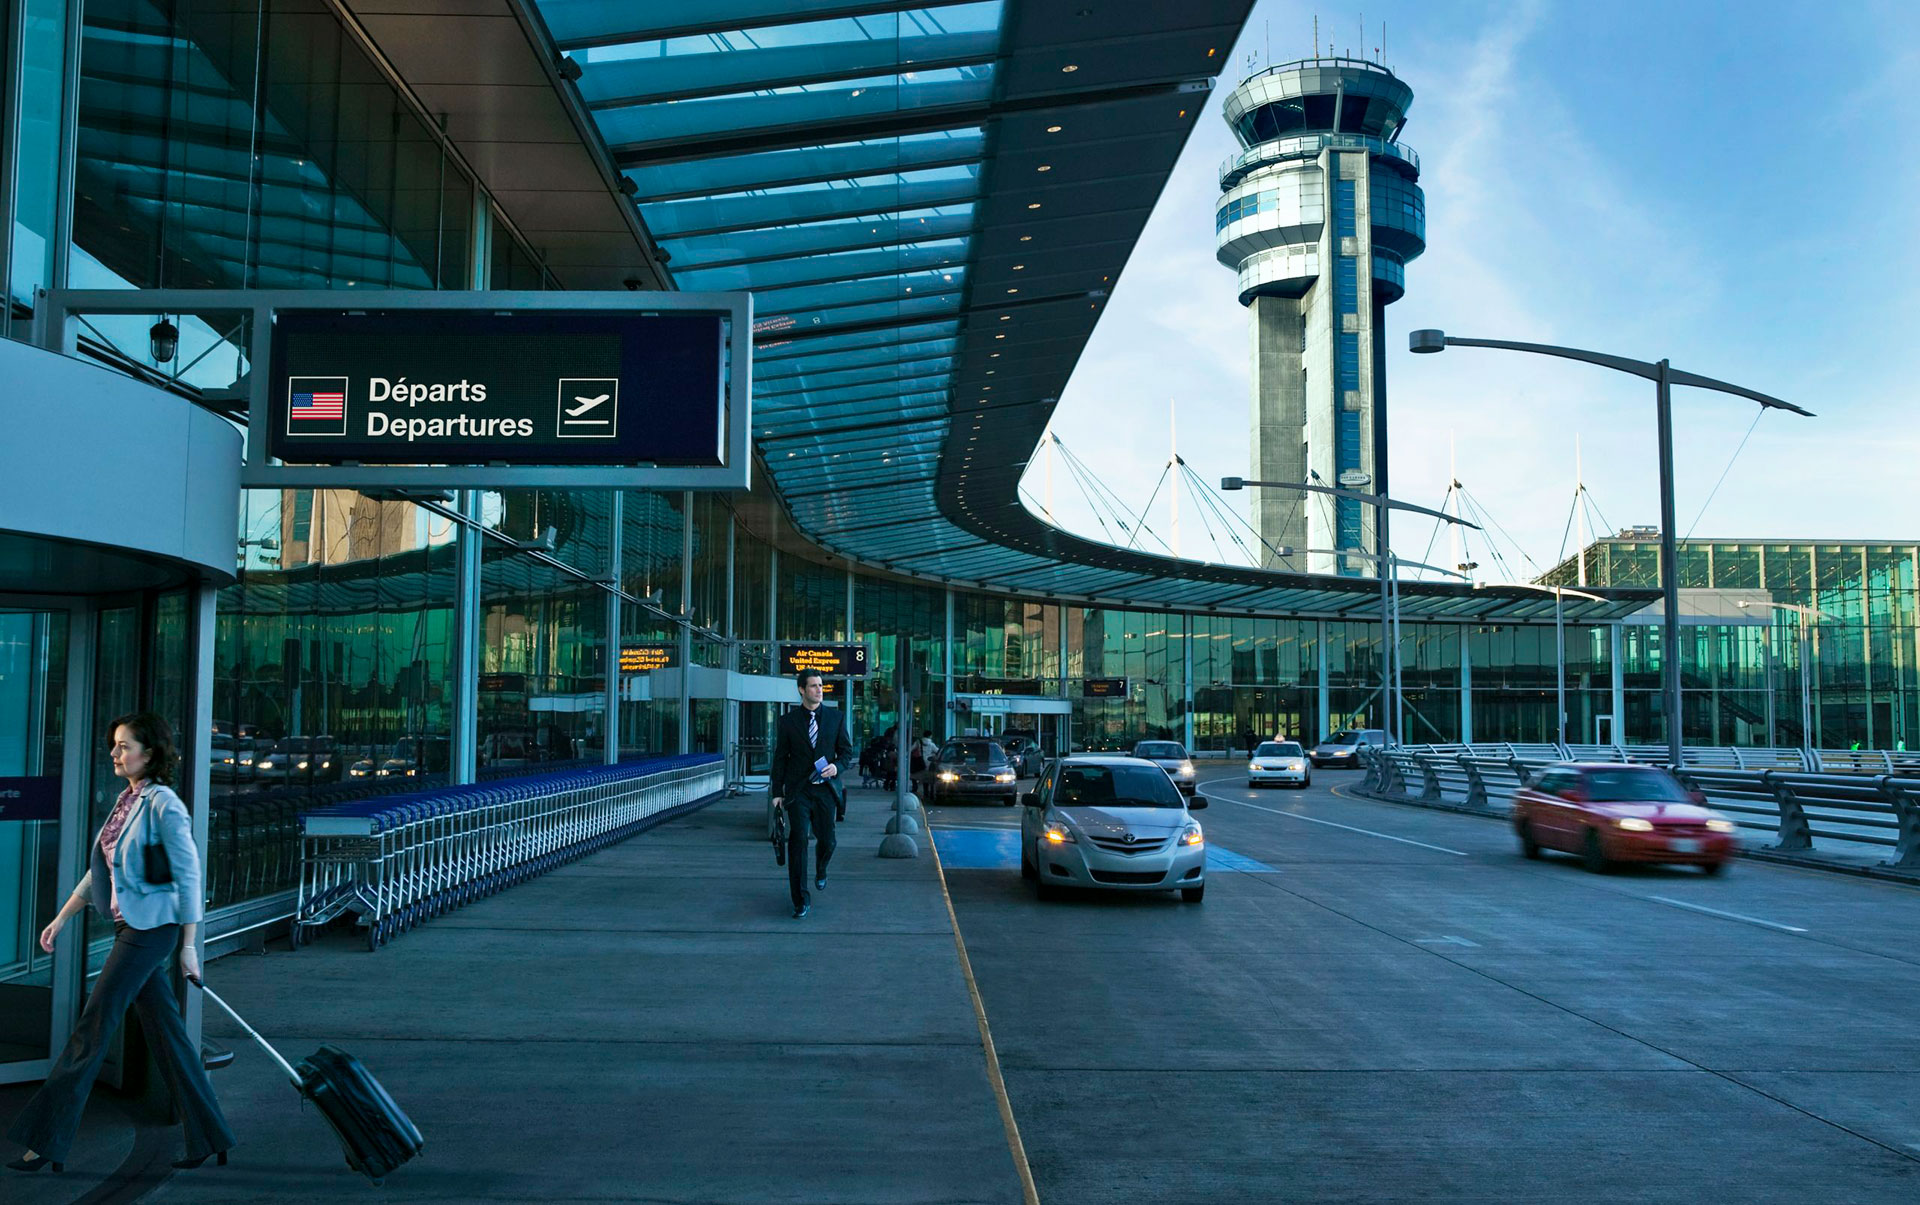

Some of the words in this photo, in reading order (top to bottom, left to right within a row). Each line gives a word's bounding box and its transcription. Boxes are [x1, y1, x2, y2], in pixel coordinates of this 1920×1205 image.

[369, 377, 487, 407] Départs
[367, 412, 534, 442] Departures
[796, 649, 807, 657] Air
[808, 649, 833, 657] Canada
[856, 650, 864, 661] 8
[813, 657, 840, 665] Express
